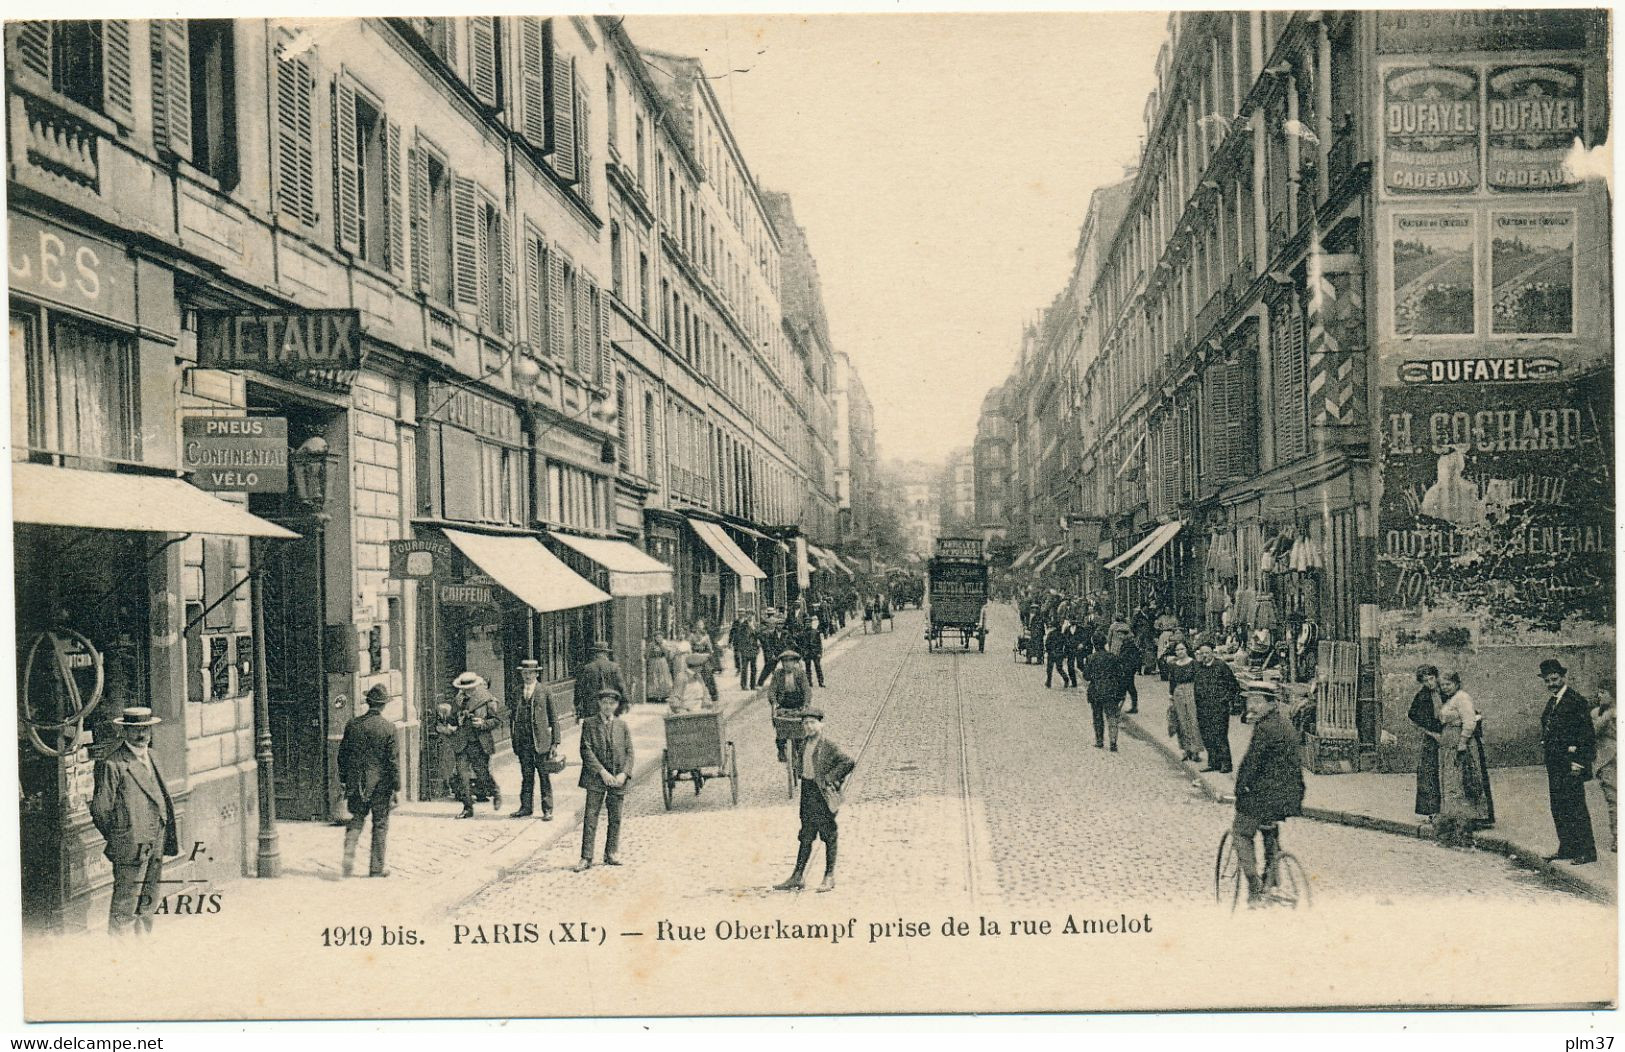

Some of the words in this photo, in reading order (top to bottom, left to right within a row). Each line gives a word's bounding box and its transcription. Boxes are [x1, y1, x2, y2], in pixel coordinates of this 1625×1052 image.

[1389, 104, 1475, 133] DUFAYEL
[1491, 101, 1578, 131] DUFAYEL
[1393, 170, 1472, 187] CADEAUX
[1496, 169, 1570, 186] CADEAU
[1431, 360, 1528, 381] DUFAYEL
[207, 421, 263, 434] PNEUS
[1390, 412, 1423, 454] H.
[392, 541, 450, 556] FOURRURES
[441, 586, 491, 602] COIFFEUR
